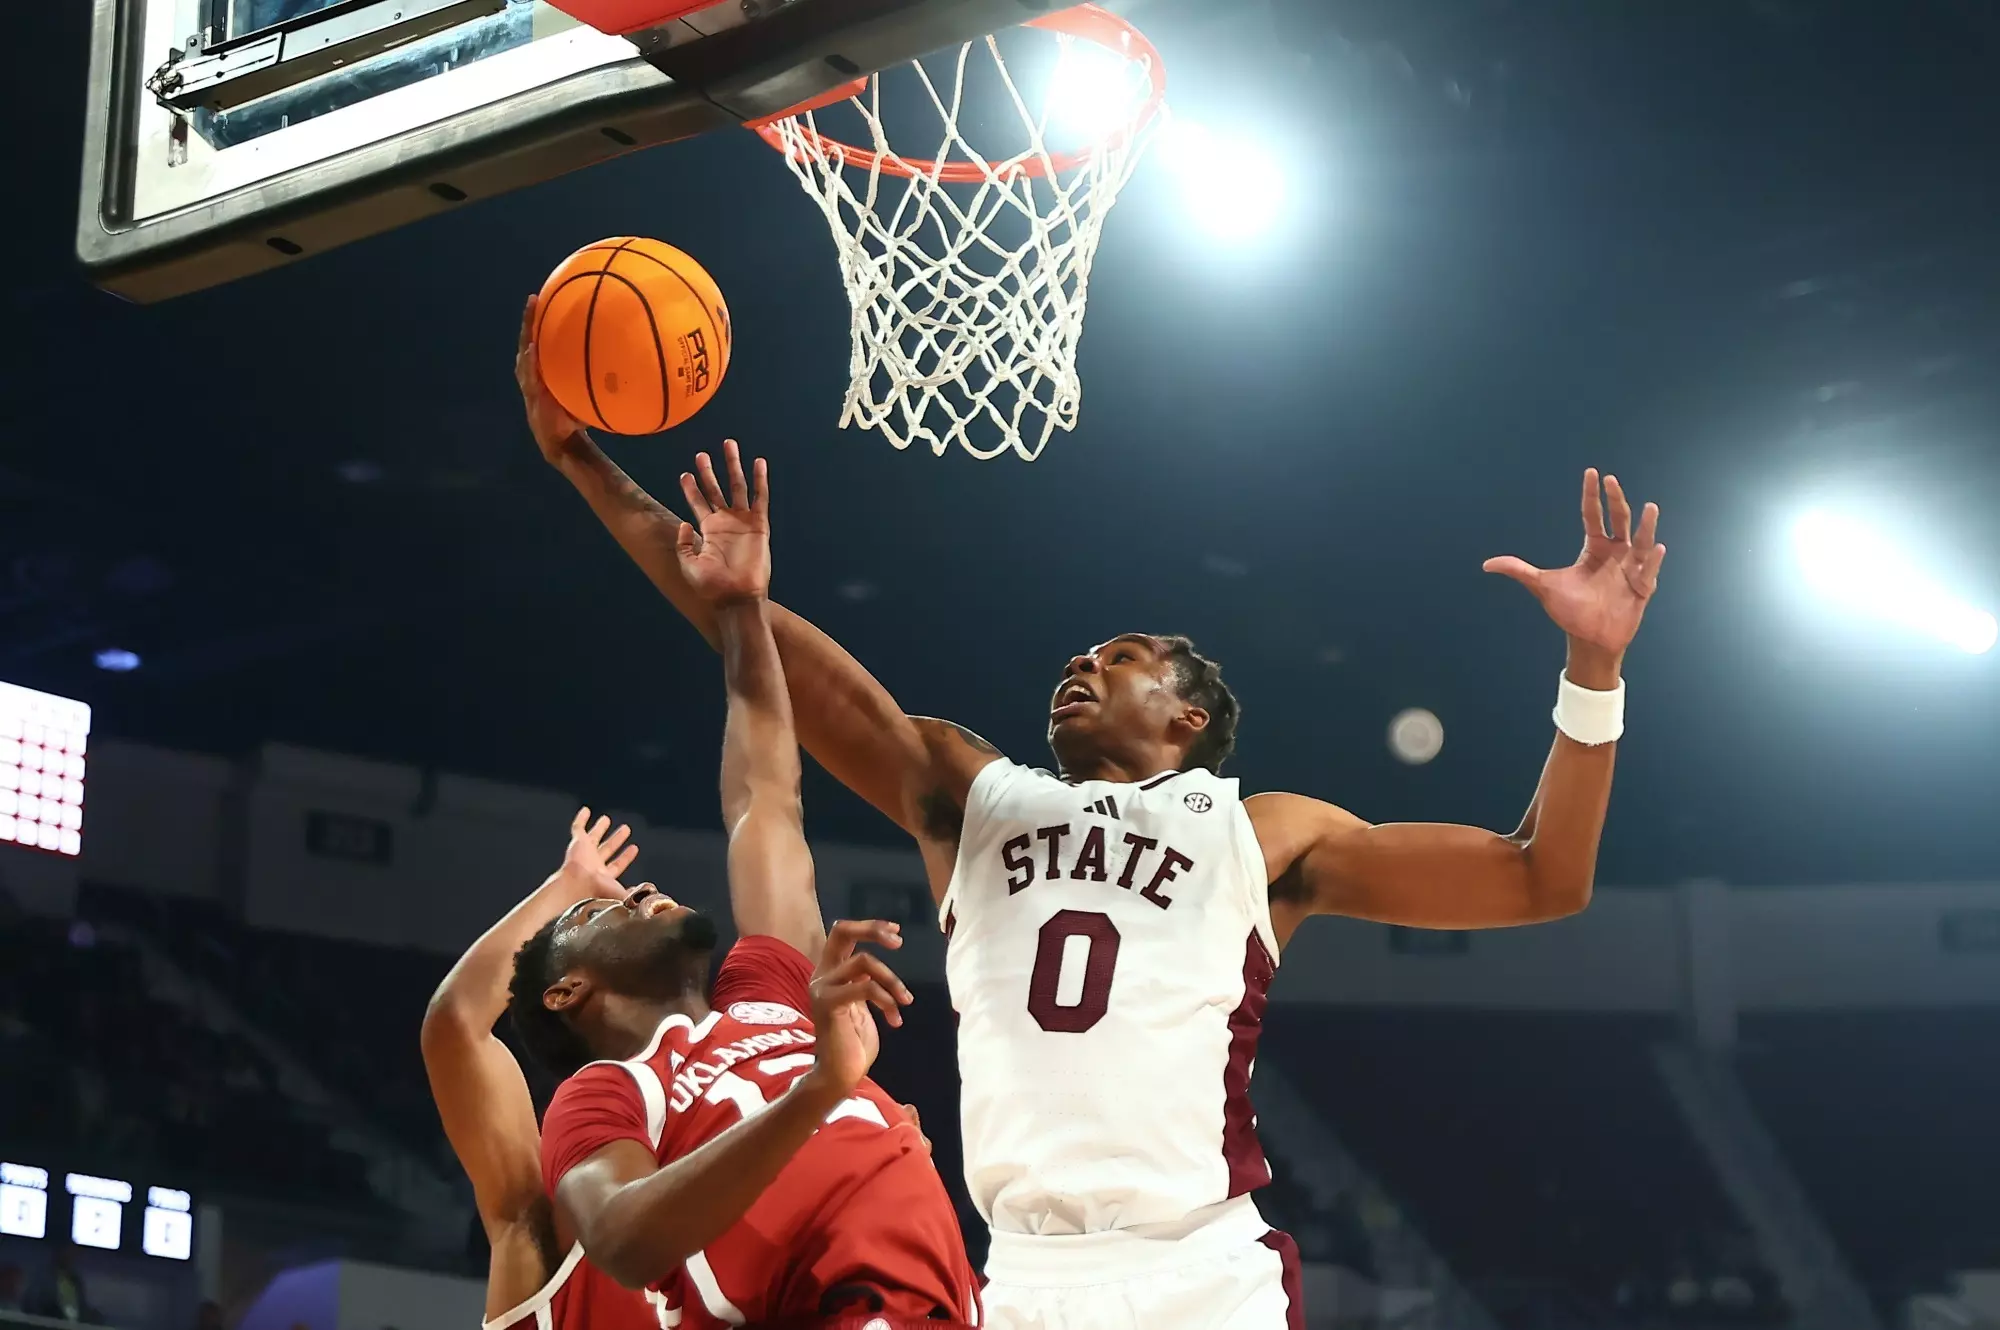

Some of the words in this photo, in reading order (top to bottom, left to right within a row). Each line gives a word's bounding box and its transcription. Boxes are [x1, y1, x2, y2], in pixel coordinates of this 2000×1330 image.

[687, 326, 710, 392] PRO
[1184, 792, 1213, 813] SEC
[1001, 823, 1194, 910] STATE
[1027, 909, 1121, 1033] 0
